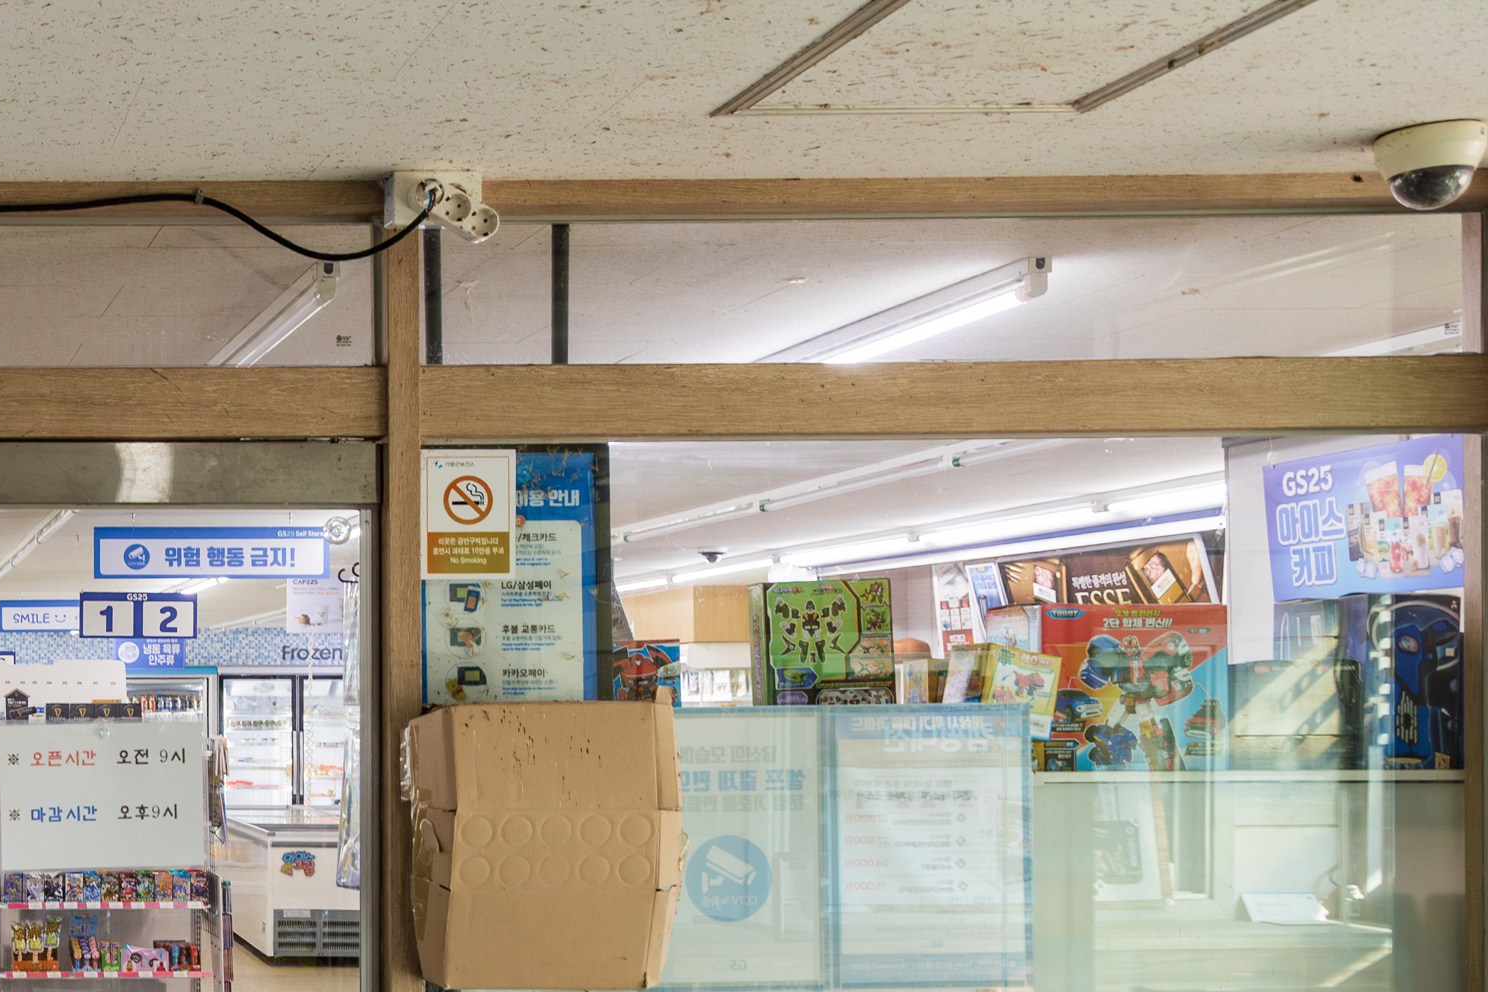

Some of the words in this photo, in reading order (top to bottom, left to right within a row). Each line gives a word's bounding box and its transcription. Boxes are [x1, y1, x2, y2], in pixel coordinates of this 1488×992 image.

[1281, 465, 1334, 497] GS25
[549, 490, 580, 507] 안내
[1276, 496, 1347, 546] 아이스
[515, 532, 558, 542] /체크카드
[164, 546, 201, 568] 위험
[207, 547, 245, 567] 행동
[250, 547, 296, 567] 금지!
[450, 556, 459, 564] No
[460, 556, 487, 565] Smoking
[1290, 541, 1338, 587] 커피
[501, 580, 552, 590] LG/삼성페이
[126, 593, 148, 601] GS25
[12, 612, 50, 625] SMILE
[99, 605, 114, 633] 1
[159, 605, 178, 633] 2
[501, 624, 519, 634] 후불
[521, 624, 556, 634] 교통카드
[281, 645, 343, 660] Frozen
[502, 668, 546, 678] 카카오페이
[30, 750, 97, 767] 오픈시간
[116, 748, 149, 765] 오전
[159, 748, 186, 765] 9시
[30, 805, 98, 823] 마감시간
